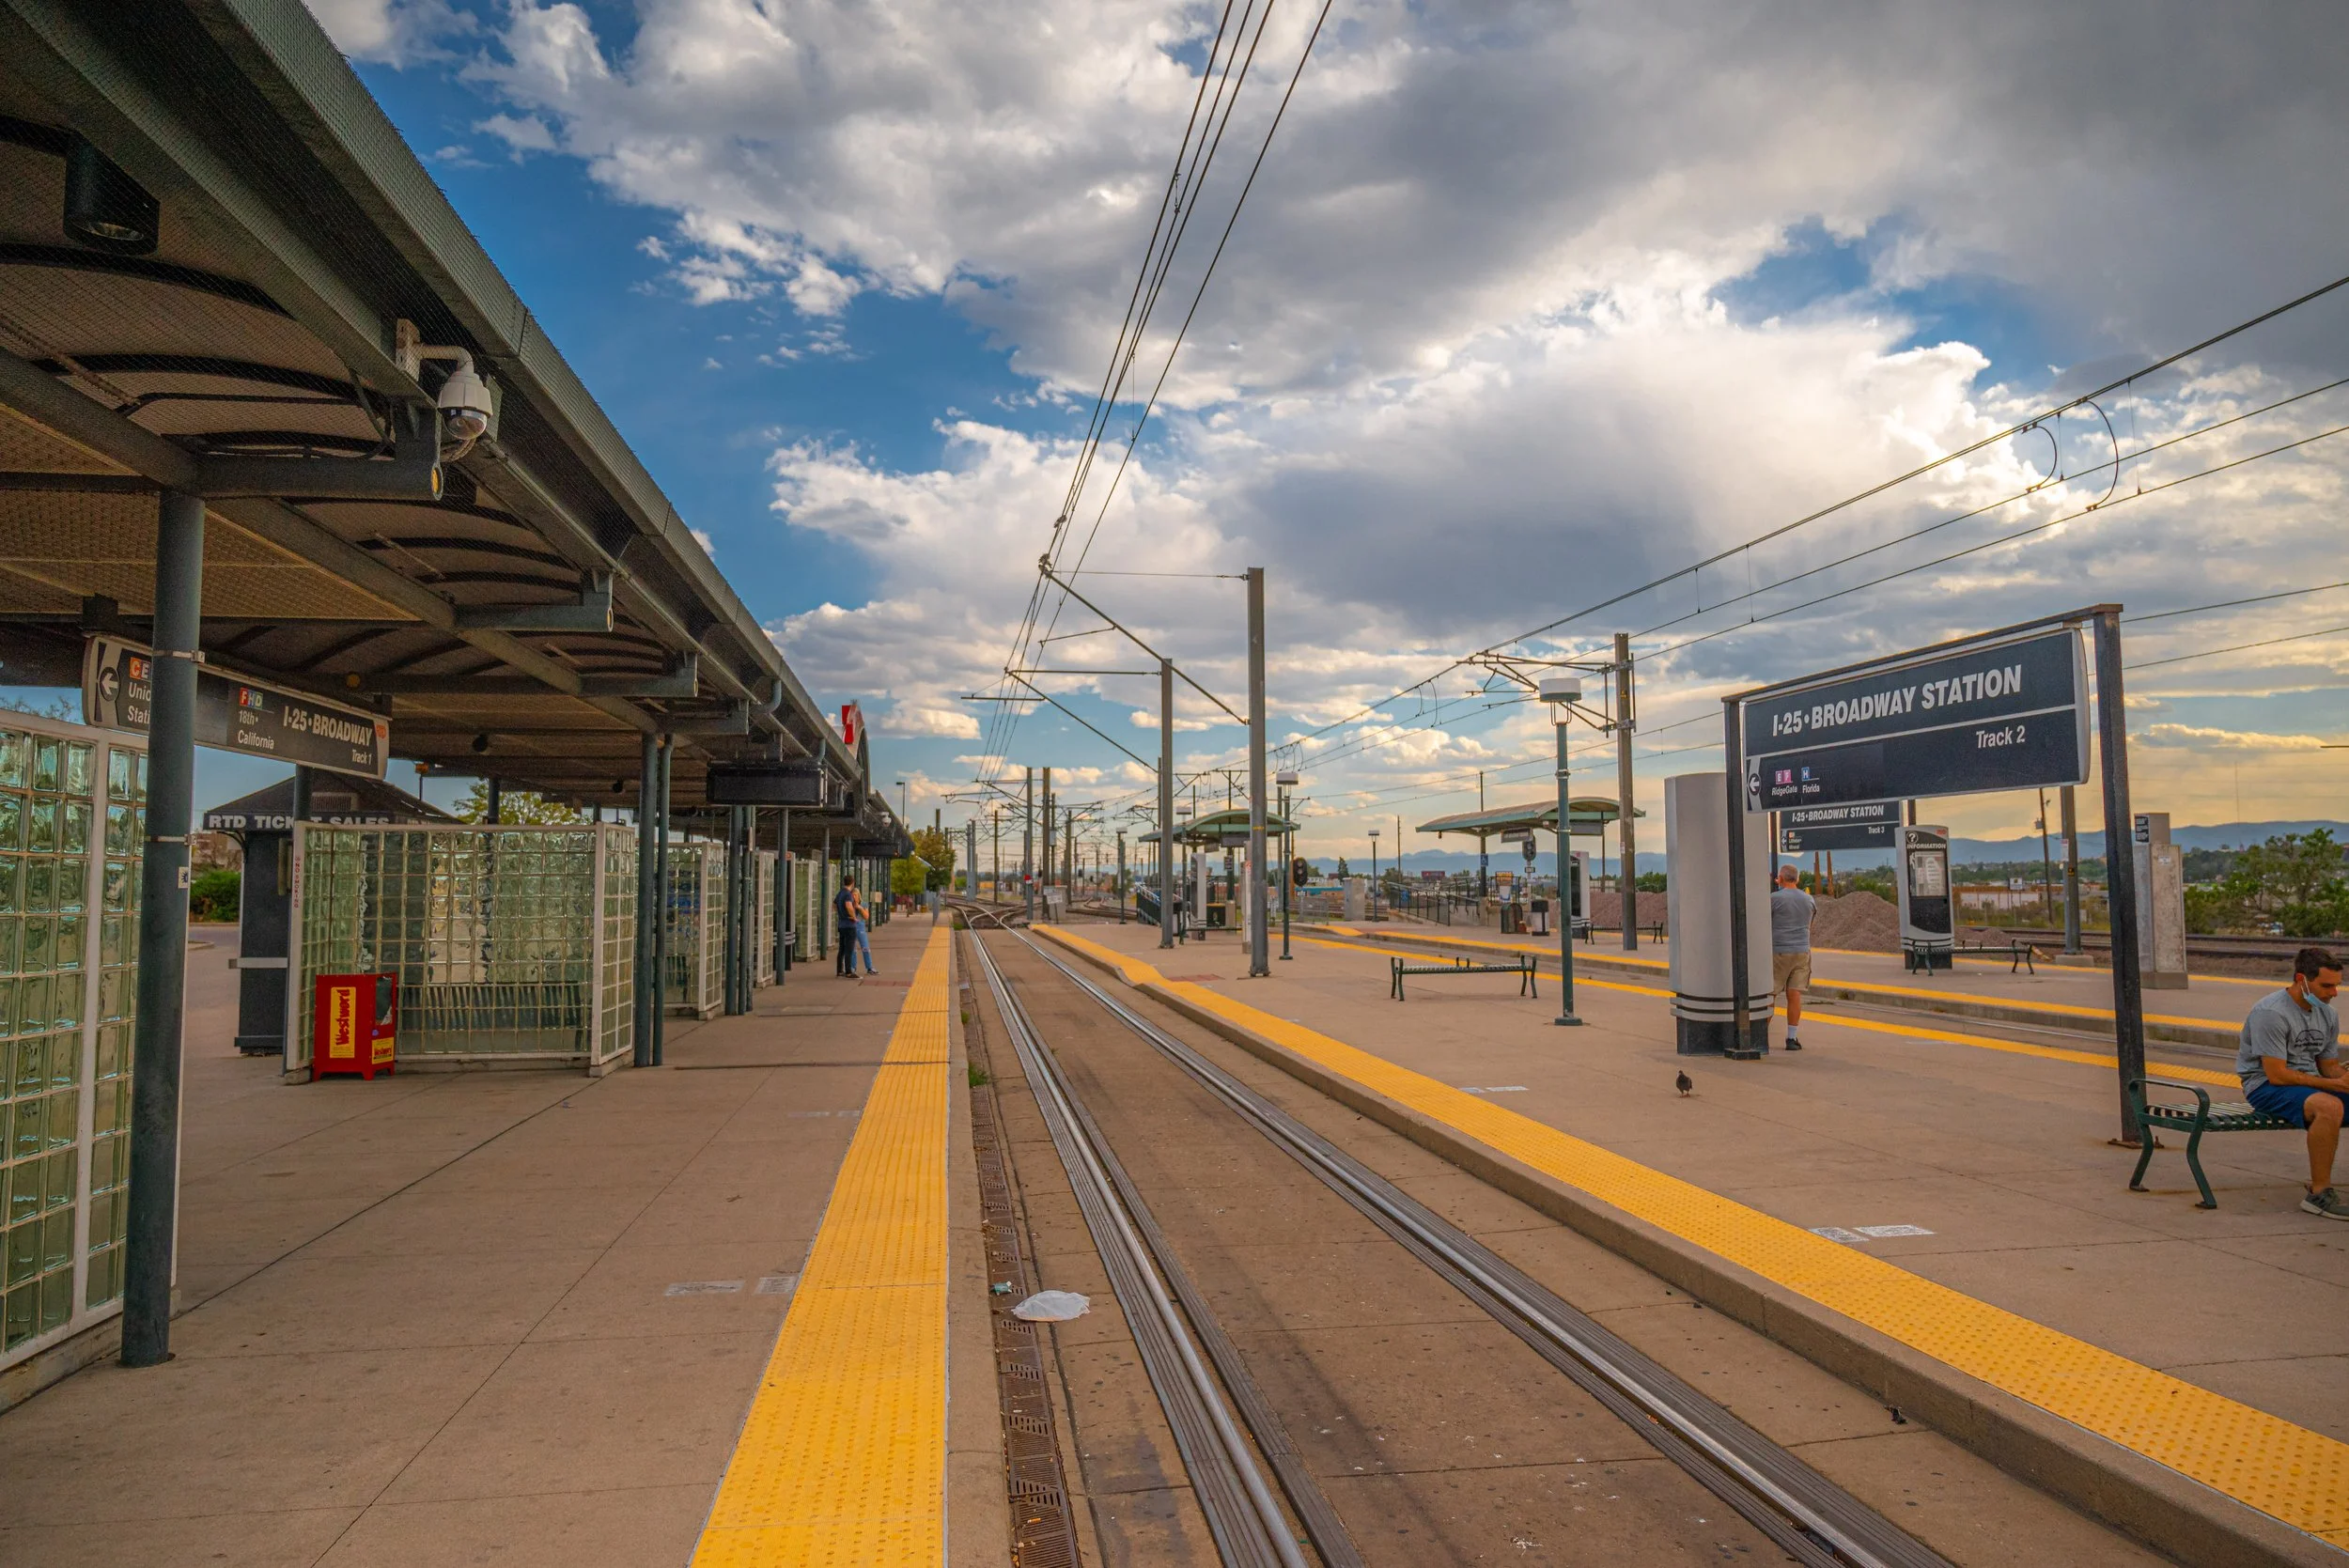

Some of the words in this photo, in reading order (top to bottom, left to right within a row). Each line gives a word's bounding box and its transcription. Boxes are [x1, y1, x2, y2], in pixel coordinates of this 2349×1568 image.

[129, 682, 151, 702] Unio
[1921, 664, 2022, 709] STATION
[128, 706, 150, 724] Stati
[238, 730, 274, 750] California
[1975, 726, 2013, 749] Track
[2016, 724, 2026, 743] 2
[352, 749, 367, 764] Track
[368, 753, 372, 766] 1
[1771, 785, 1797, 797] RidgeGate
[1802, 784, 1820, 794] Florida
[1850, 805, 1885, 817] STATION
[209, 815, 246, 829] RTD
[255, 815, 323, 829] TICKT
